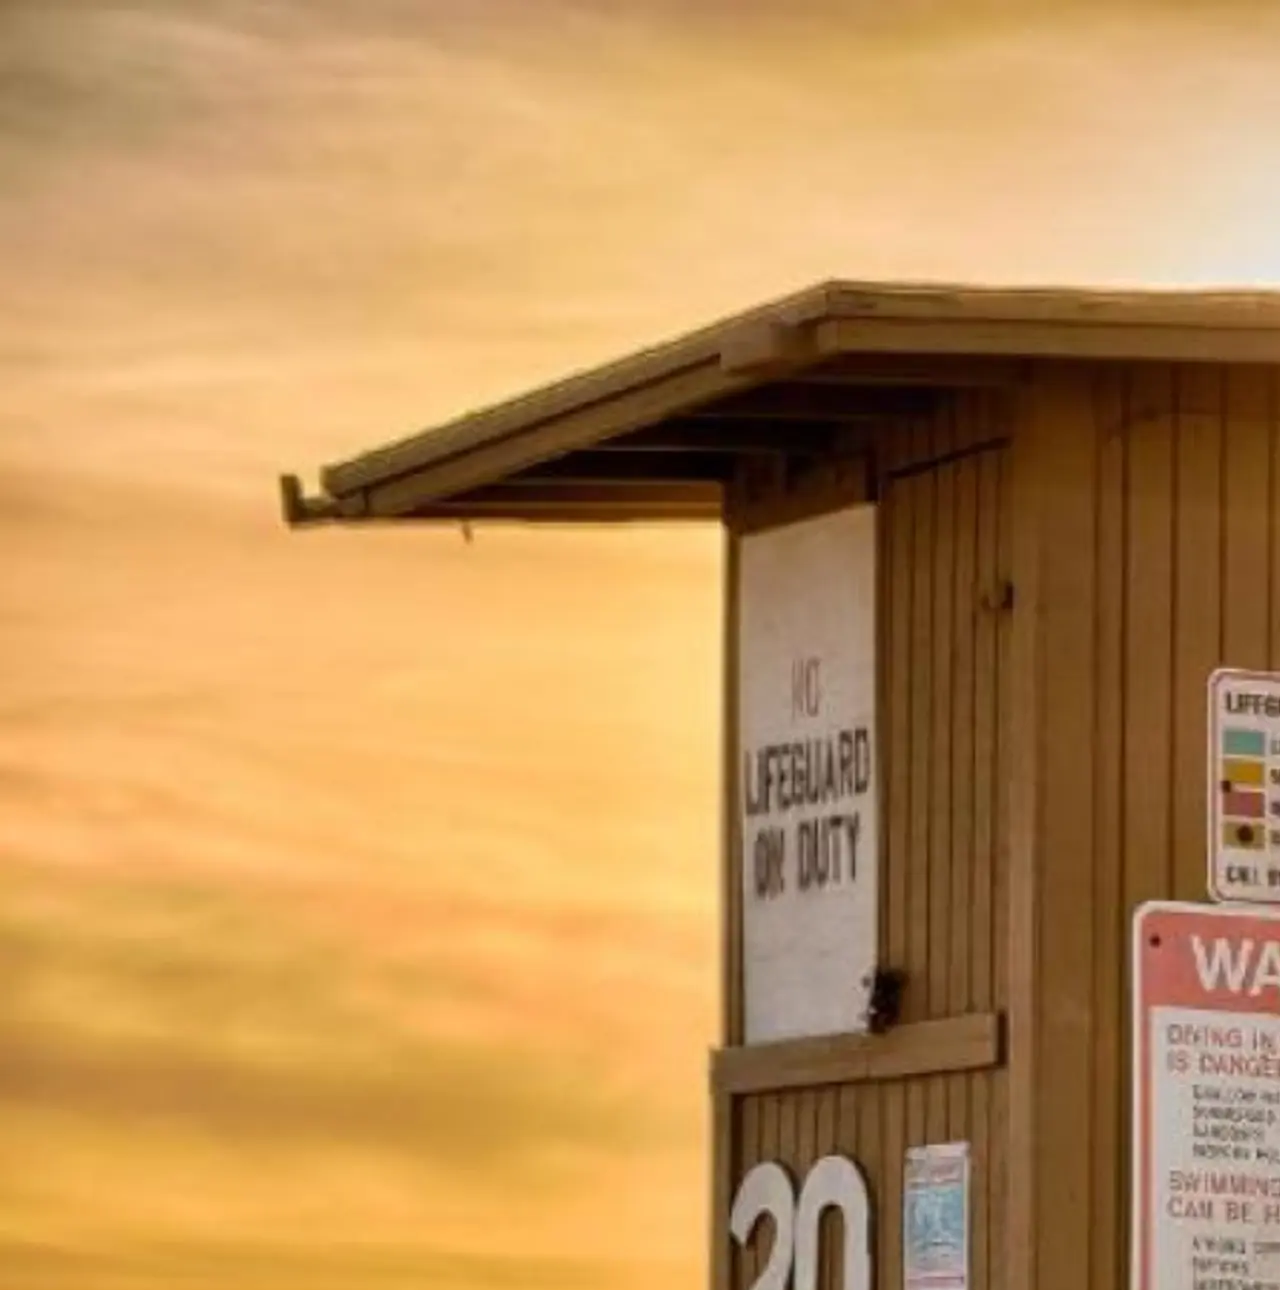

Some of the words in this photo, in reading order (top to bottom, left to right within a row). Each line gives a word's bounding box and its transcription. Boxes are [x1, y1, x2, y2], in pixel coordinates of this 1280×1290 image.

[791, 656, 821, 722] NO
[746, 727, 871, 817] LIFEGUARD
[754, 826, 784, 900] ON
[797, 812, 860, 892] DUTY
[1166, 1024, 1242, 1048] DIVING
[1252, 1027, 1274, 1050] IN
[1166, 1196, 1213, 1219] CAN
[1225, 1201, 1252, 1224] BE
